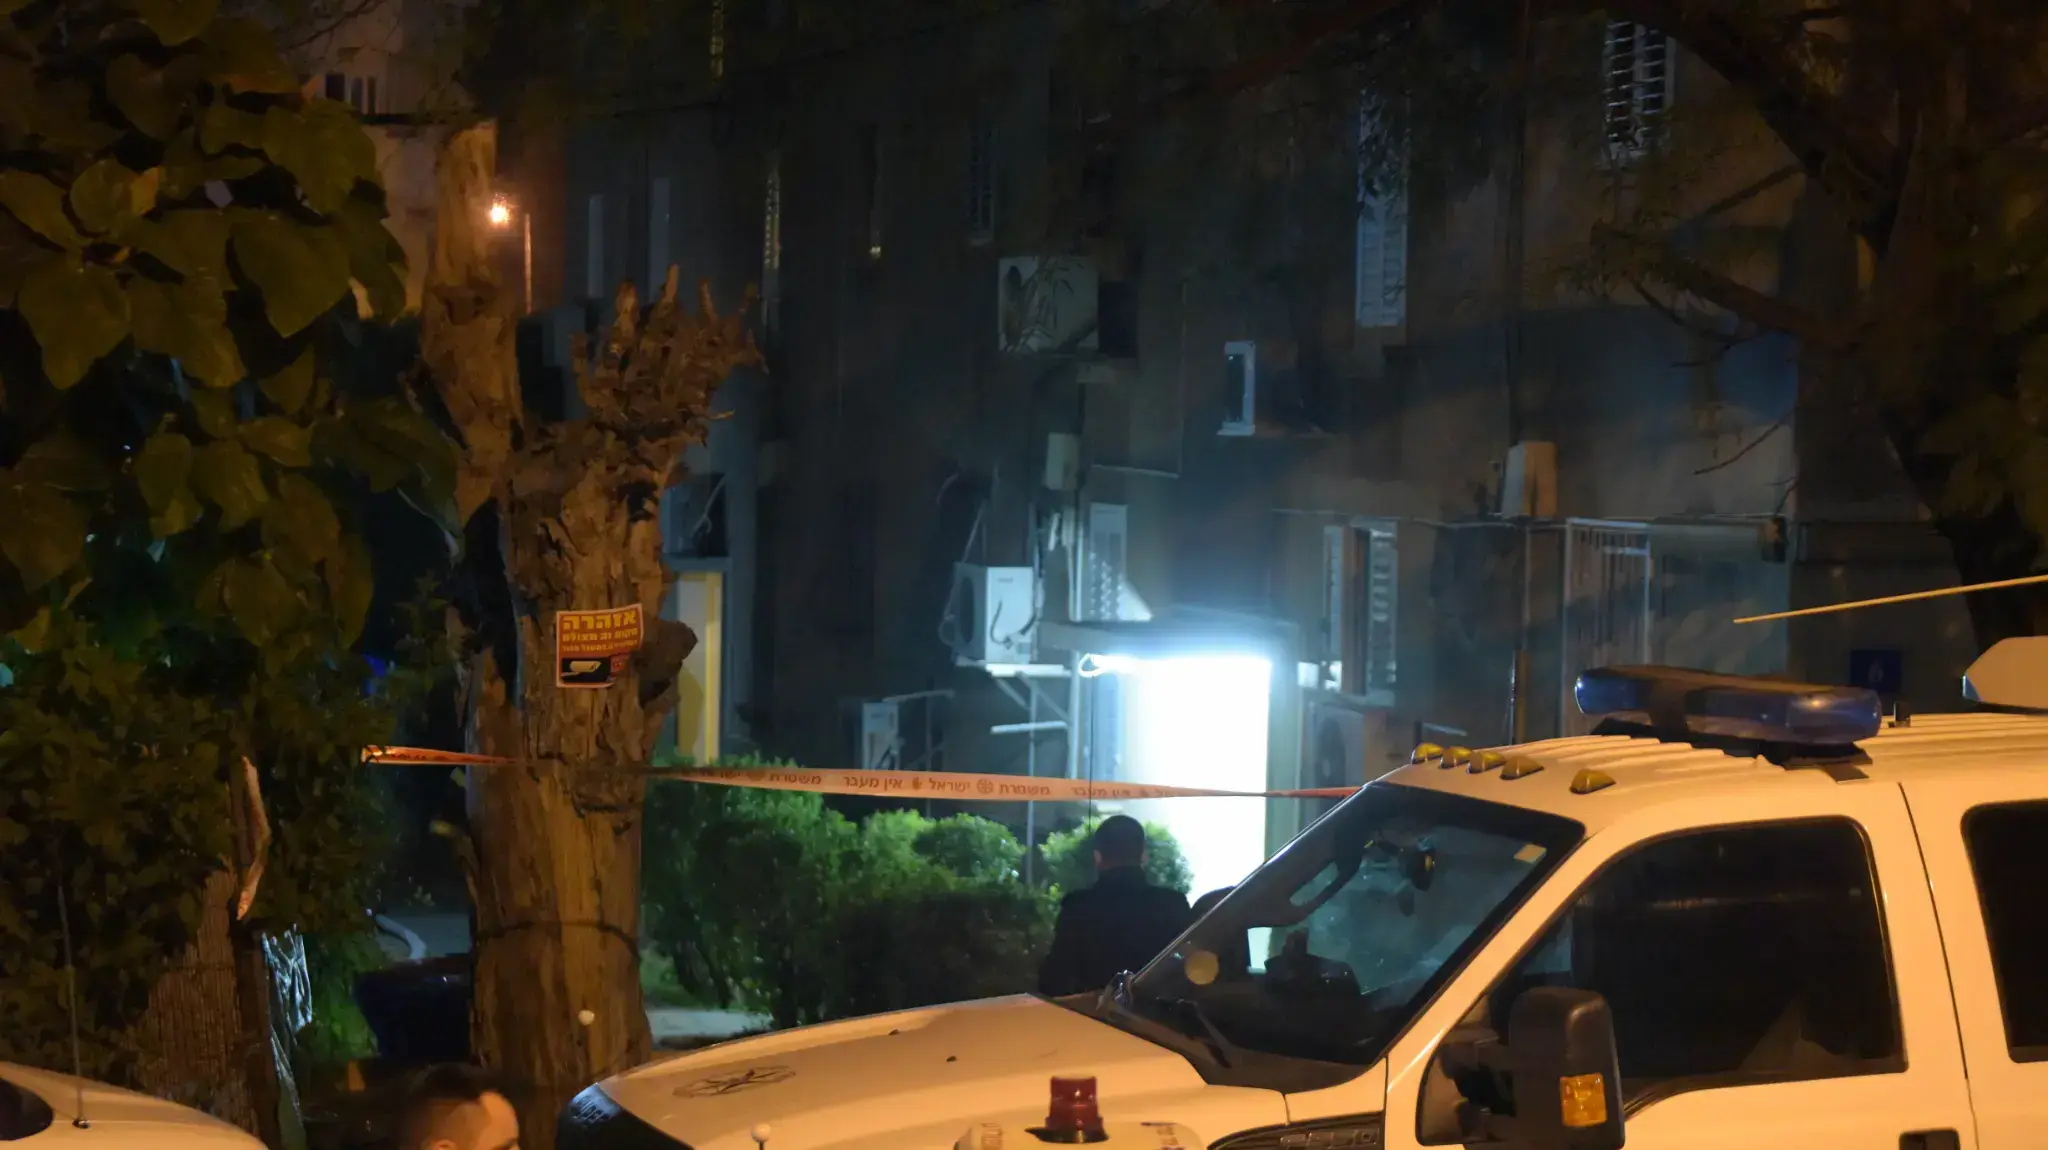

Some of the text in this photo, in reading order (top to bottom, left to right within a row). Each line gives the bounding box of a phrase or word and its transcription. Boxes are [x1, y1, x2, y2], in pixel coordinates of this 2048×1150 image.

[563, 610, 636, 629] אזהרה
[562, 631, 598, 642] מצולם
[600, 632, 612, 641] זה
[843, 776, 880, 789] מעבר
[884, 776, 903, 791] אין
[928, 778, 971, 791] ישראל
[999, 782, 1051, 795] משטרת
